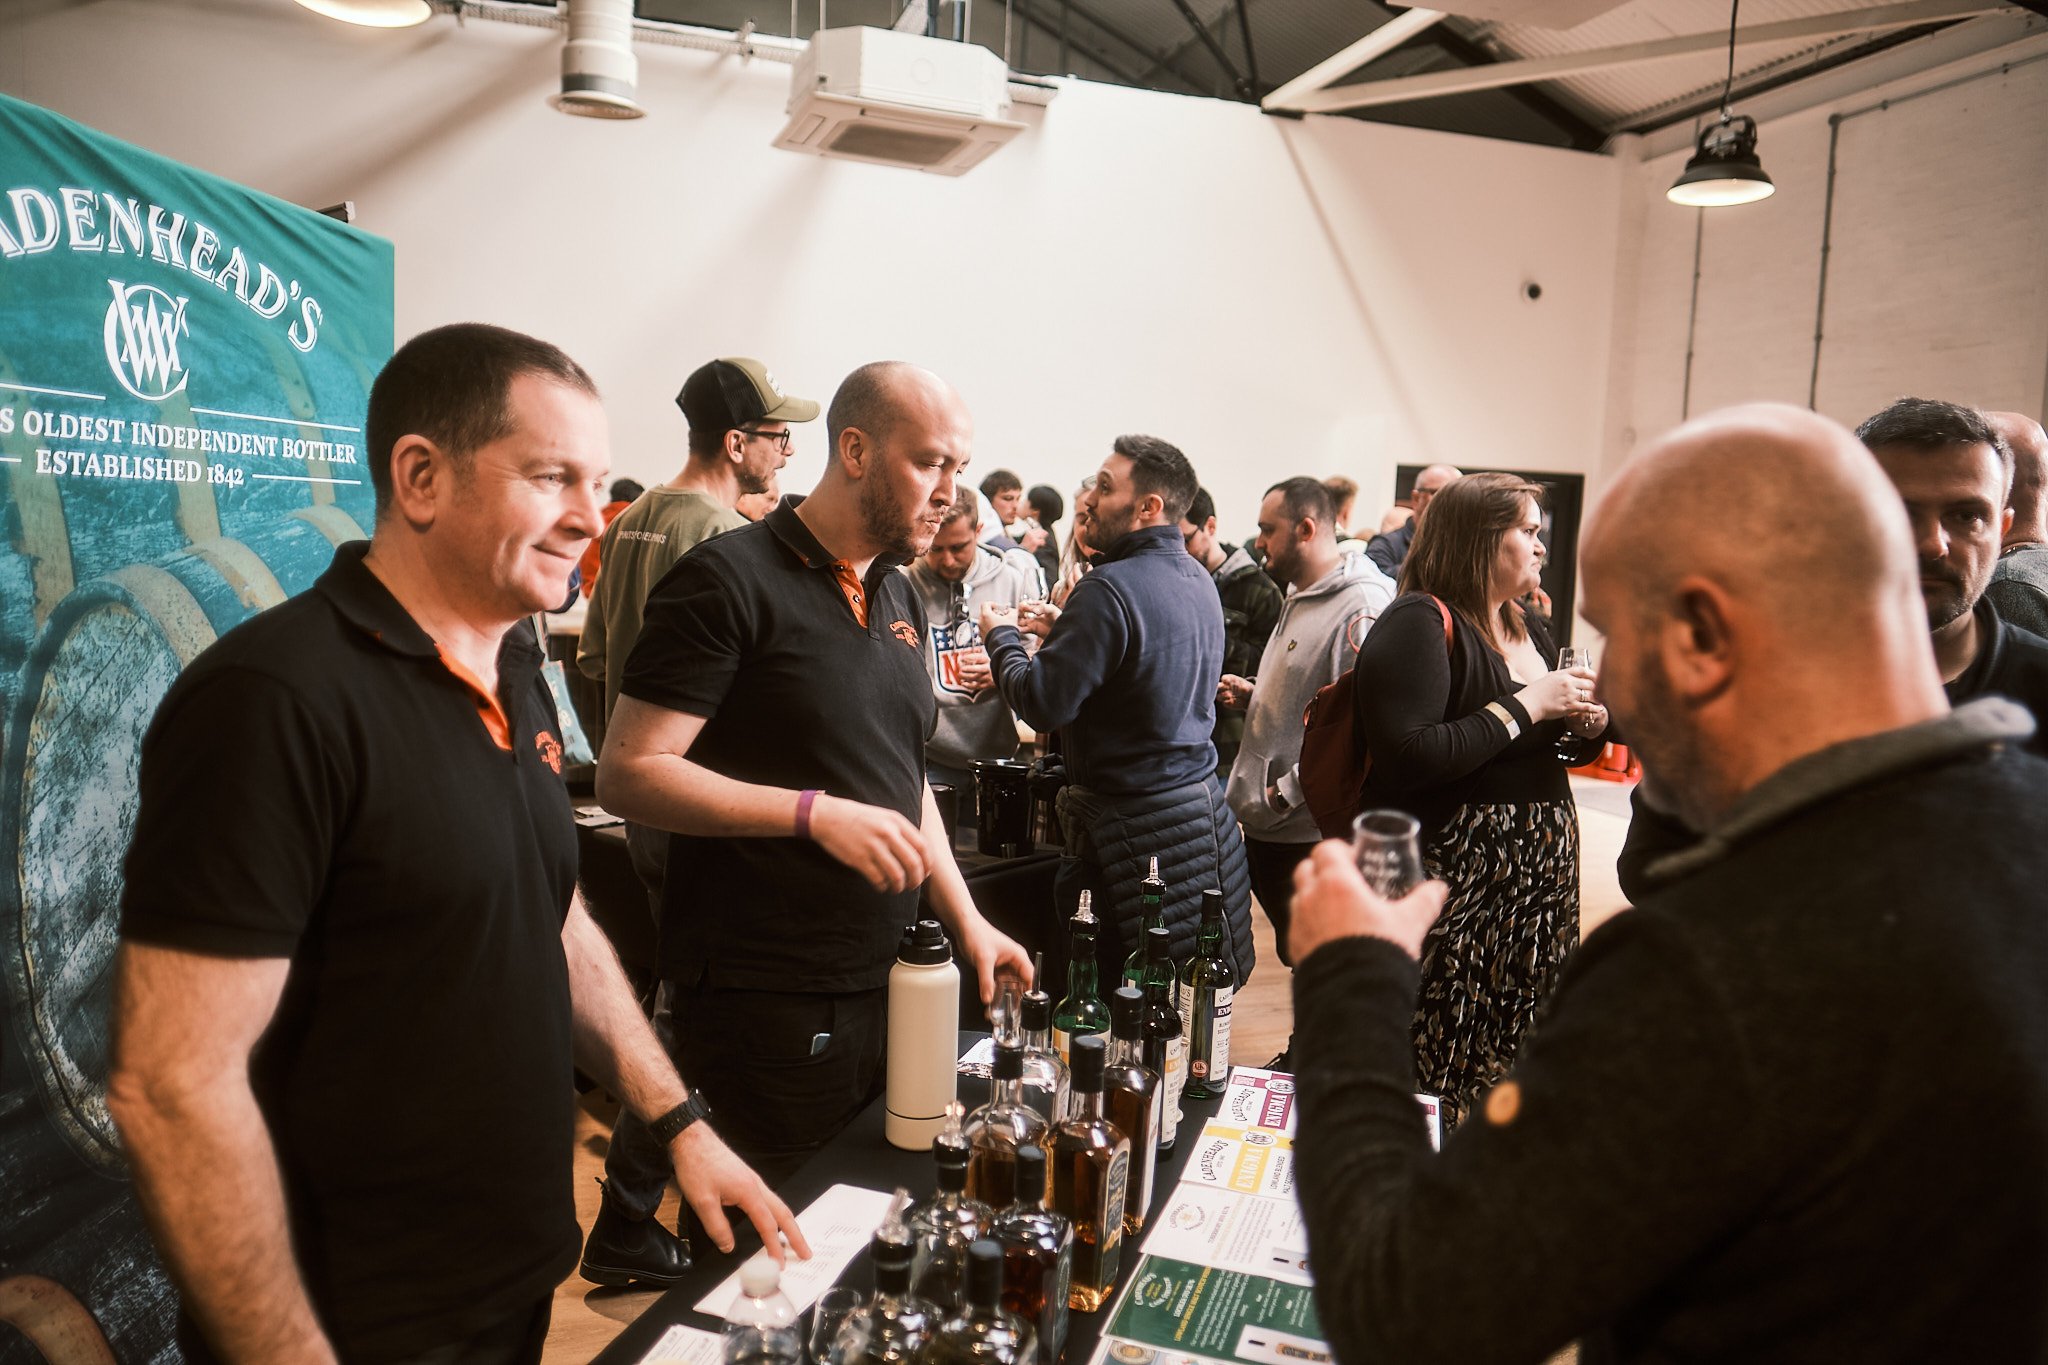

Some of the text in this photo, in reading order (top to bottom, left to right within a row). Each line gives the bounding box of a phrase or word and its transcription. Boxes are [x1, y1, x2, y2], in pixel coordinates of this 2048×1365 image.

[23, 411, 125, 443] OLDEST
[131, 421, 278, 457] INDEPENDENT
[282, 437, 357, 464] BOTTLER
[36, 449, 244, 489] ESTABLISHED 1842
[1264, 1094, 1288, 1127] ENIGMA
[1201, 1140, 1229, 1180] CADENHEAD'S
[1235, 1148, 1265, 1188] ENIGMA
